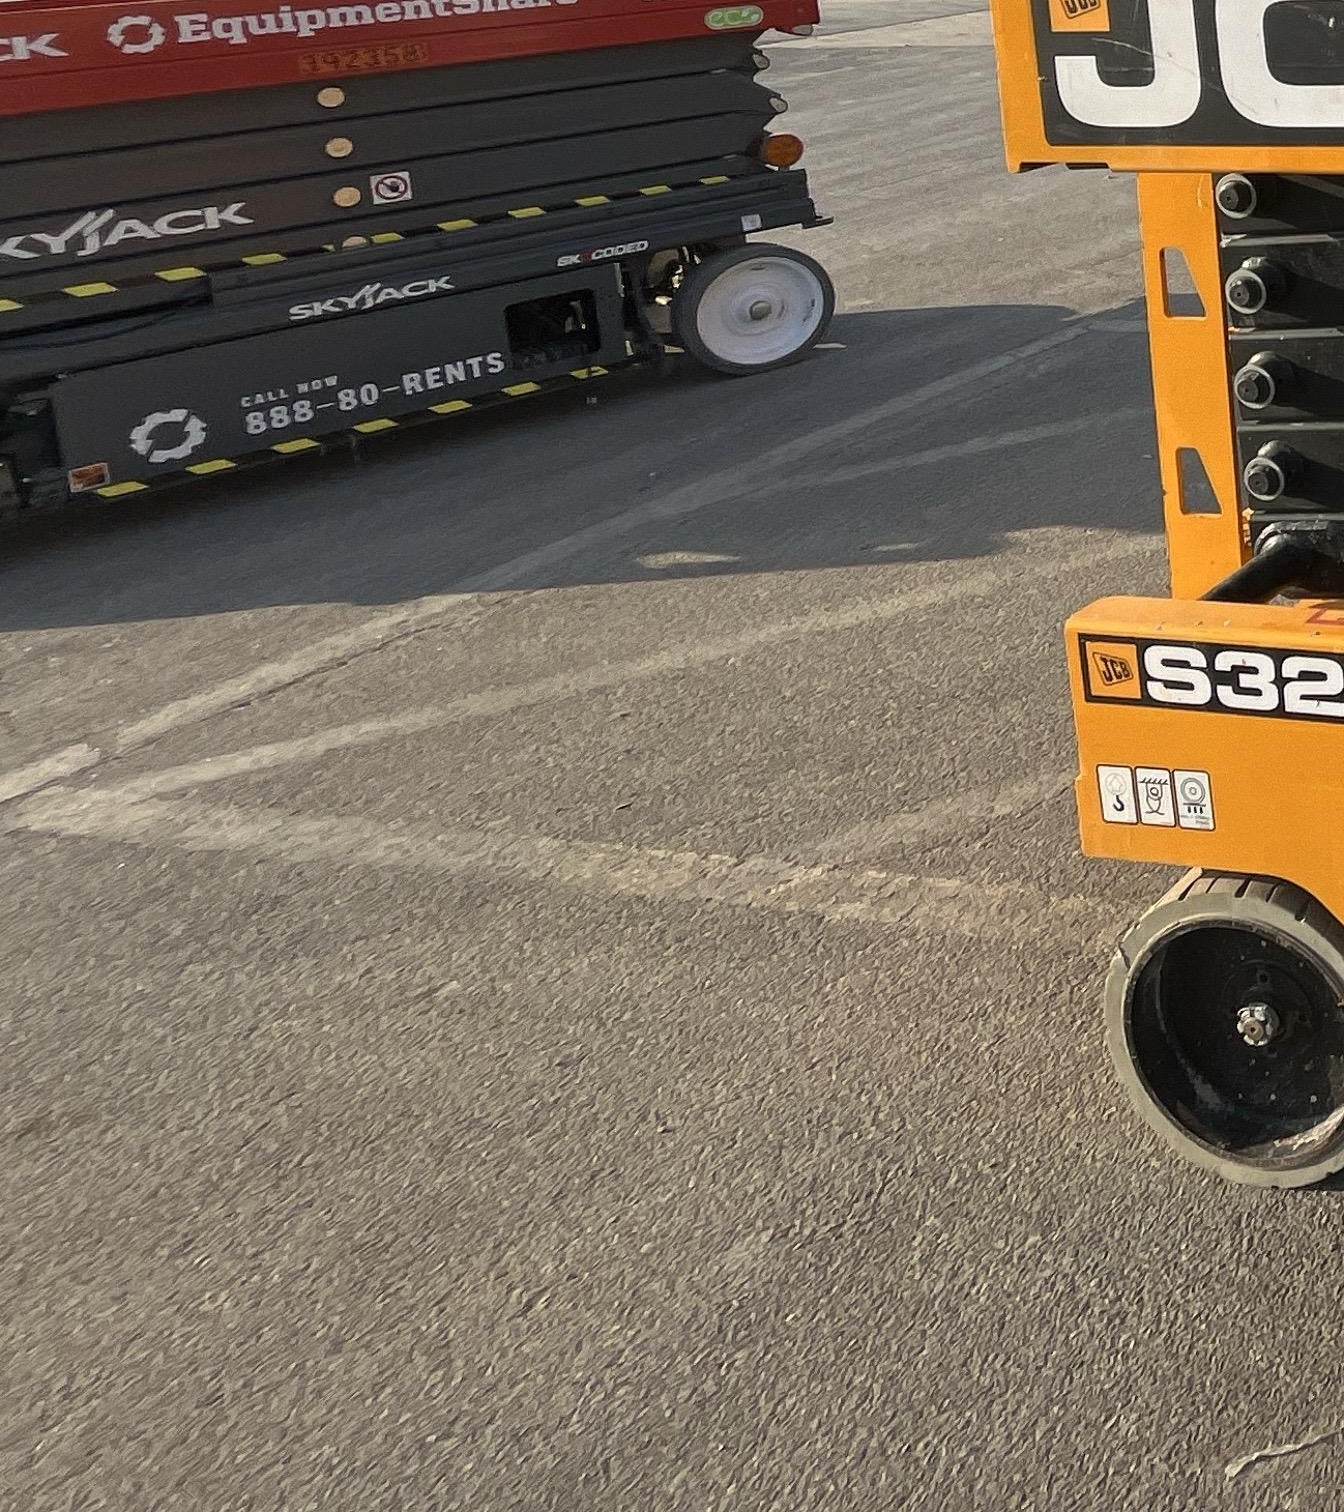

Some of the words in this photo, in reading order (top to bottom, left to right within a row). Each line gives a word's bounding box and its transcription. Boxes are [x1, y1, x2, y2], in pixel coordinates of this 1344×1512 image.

[289, 275, 456, 322] SKYJACK
[240, 387, 289, 408] CALL
[296, 374, 338, 394] NOW
[244, 351, 506, 435] 888-80-RENTS
[1100, 656, 1132, 683] JCB
